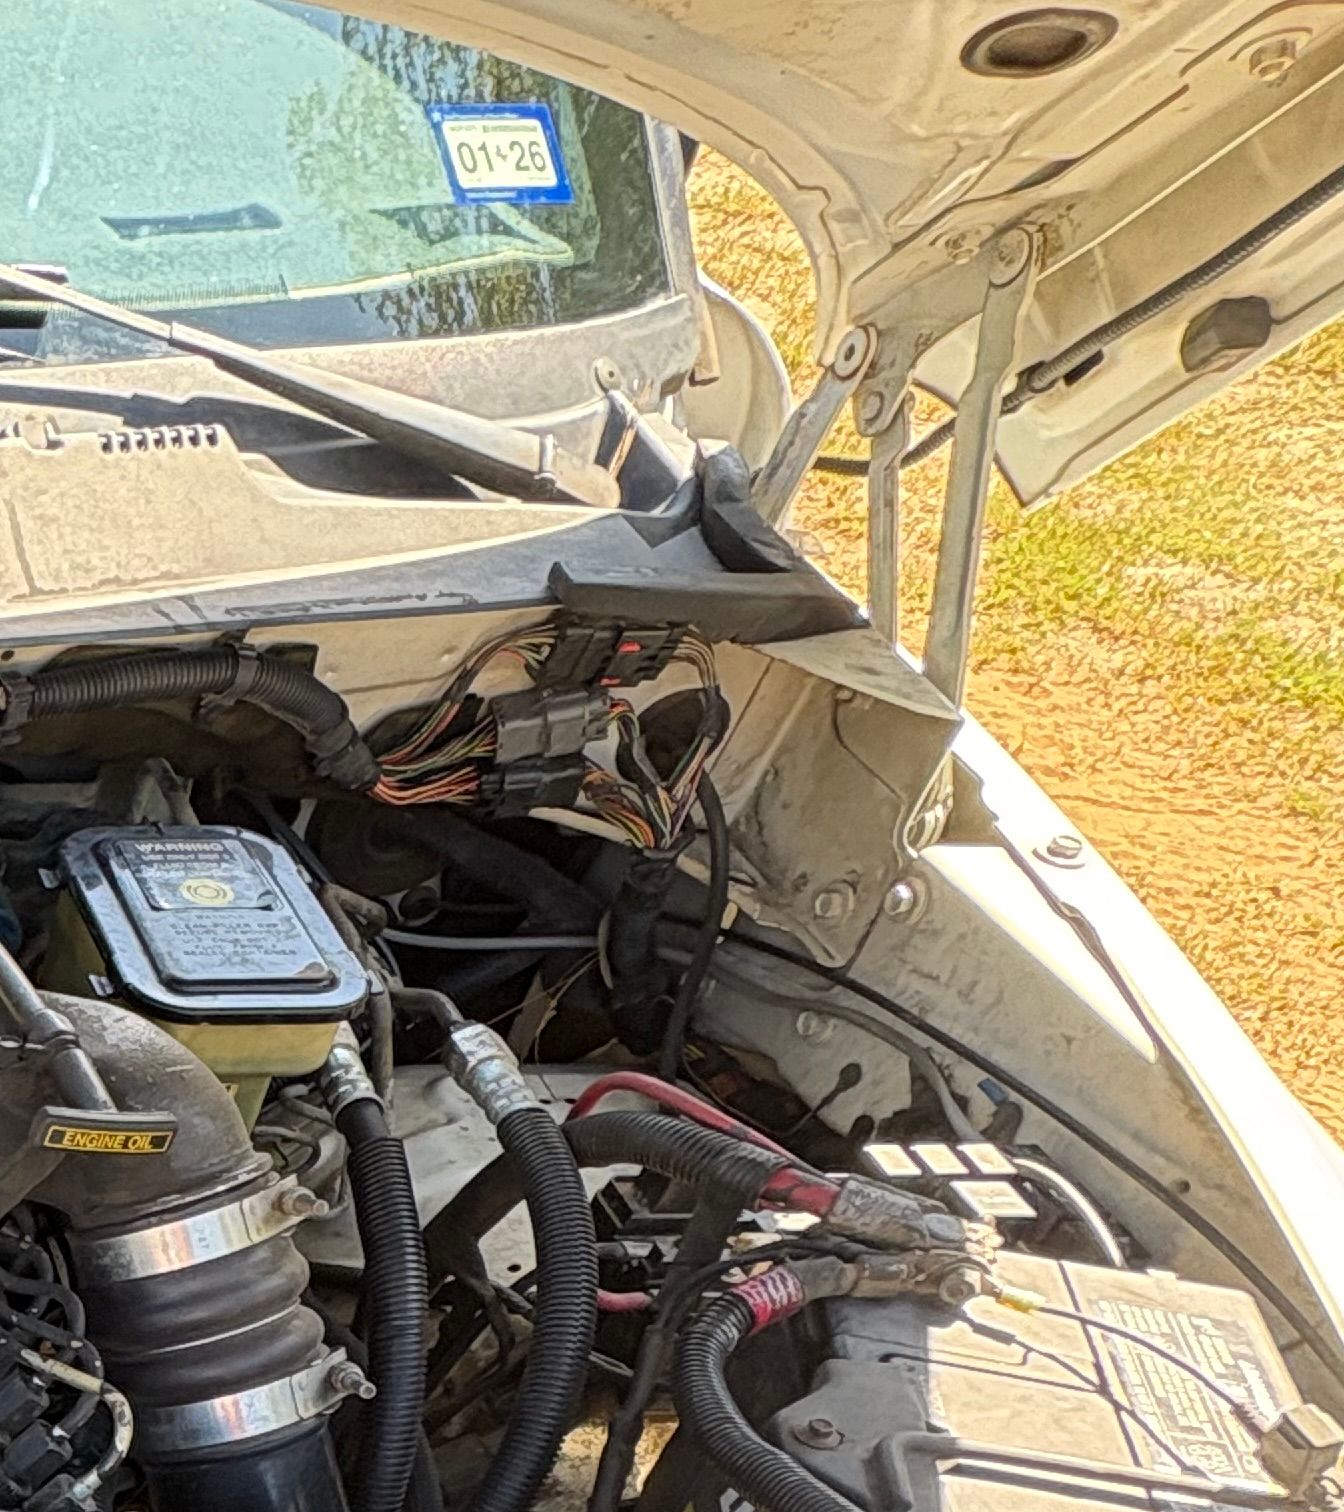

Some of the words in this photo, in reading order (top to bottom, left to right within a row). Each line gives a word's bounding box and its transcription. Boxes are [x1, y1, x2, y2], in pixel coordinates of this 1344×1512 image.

[456, 141, 494, 174] 01
[509, 140, 547, 172] 26
[63, 1132, 125, 1149] ENGINE
[127, 1134, 153, 1150] OIL
